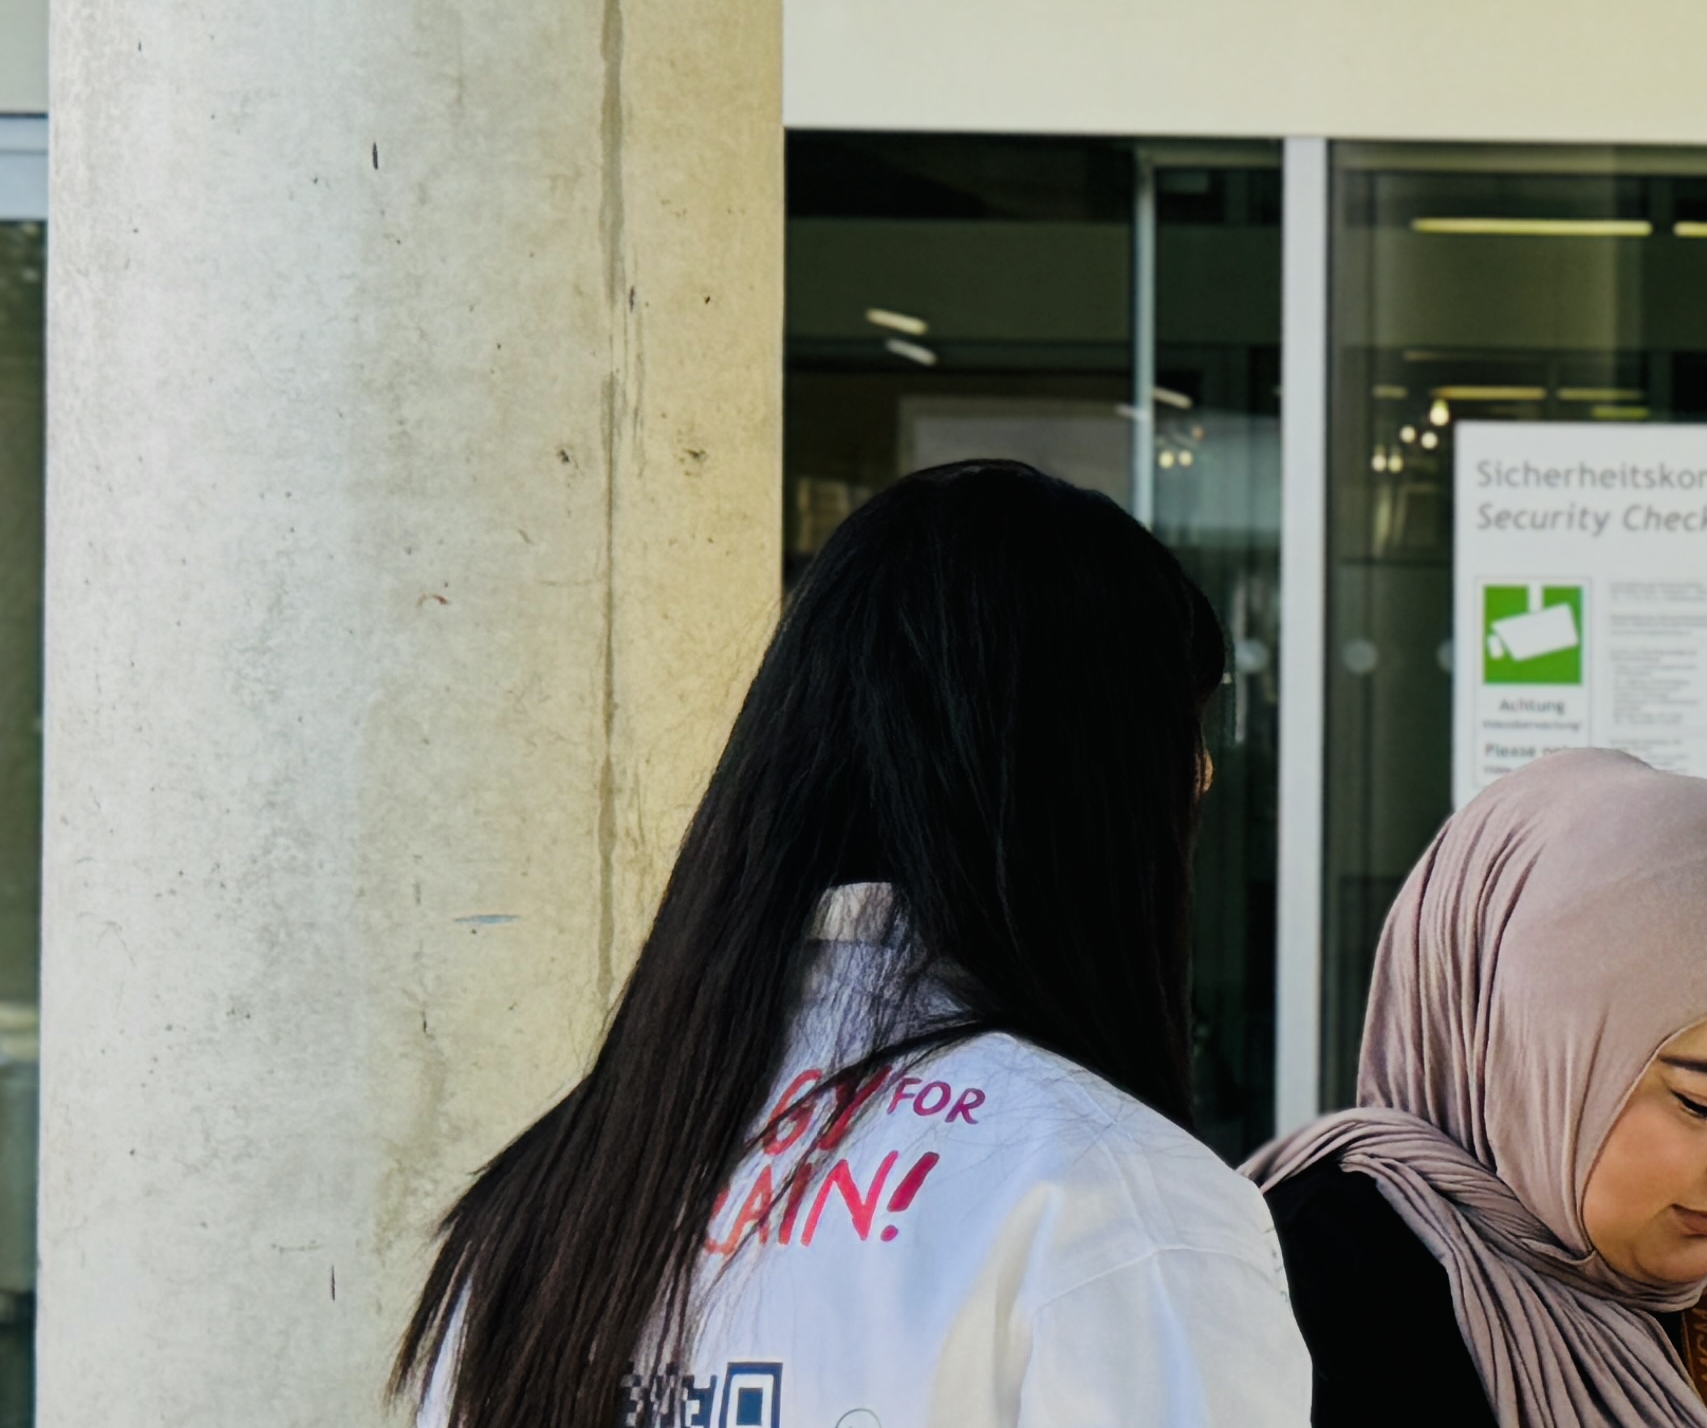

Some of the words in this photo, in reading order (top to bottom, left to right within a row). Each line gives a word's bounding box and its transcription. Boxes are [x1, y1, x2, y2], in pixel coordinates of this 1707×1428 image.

[1476, 503, 1611, 536] Security
[1498, 698, 1566, 716] Achtung
[887, 1076, 986, 1125] FOR
